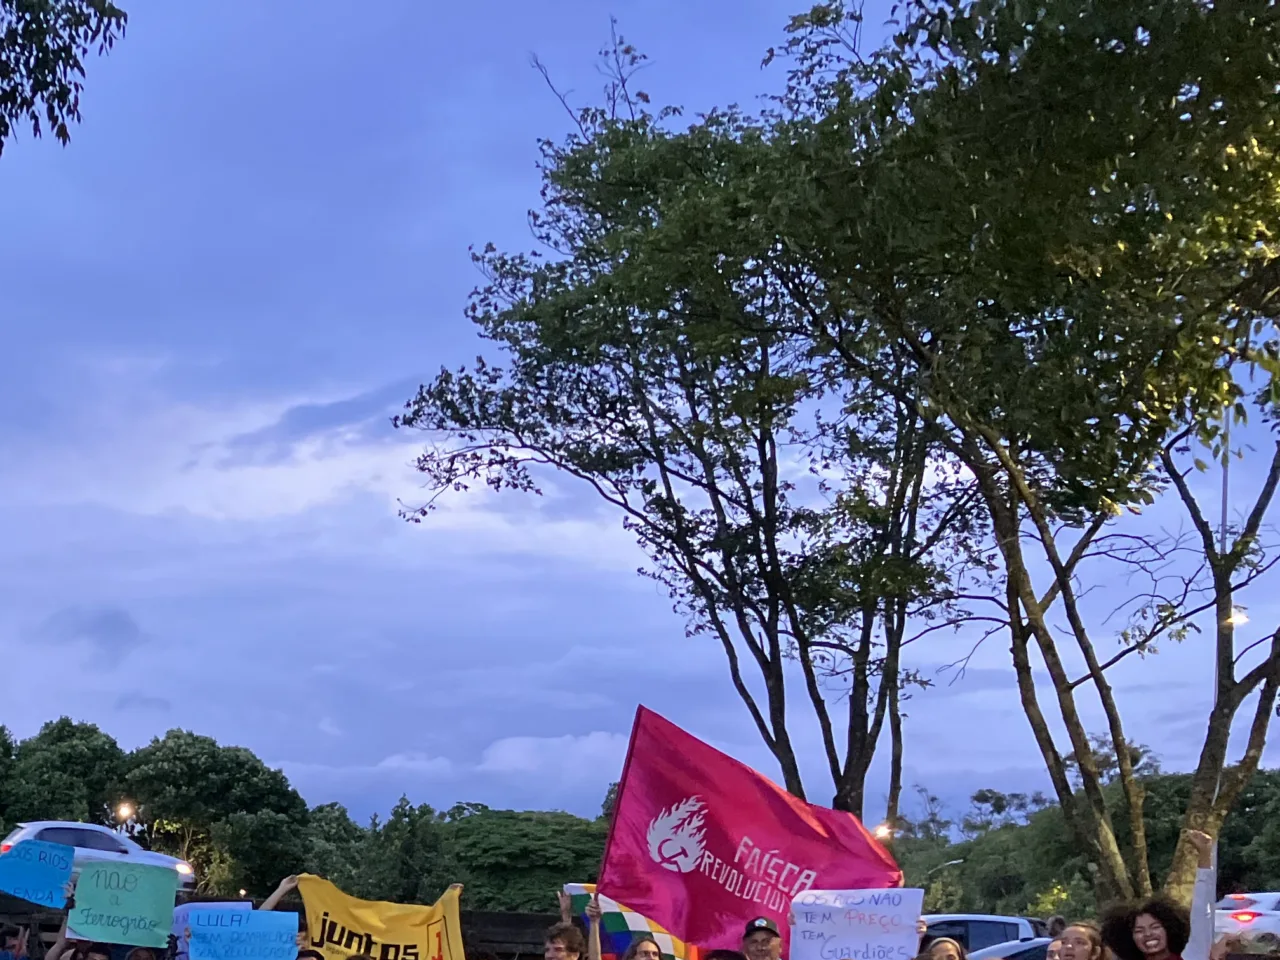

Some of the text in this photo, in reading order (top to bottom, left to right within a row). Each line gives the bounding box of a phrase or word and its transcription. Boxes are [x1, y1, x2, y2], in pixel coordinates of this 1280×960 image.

[38, 850, 70, 871] RIOS
[13, 887, 55, 904] ENDA
[804, 909, 903, 934] TEM PREÇO
